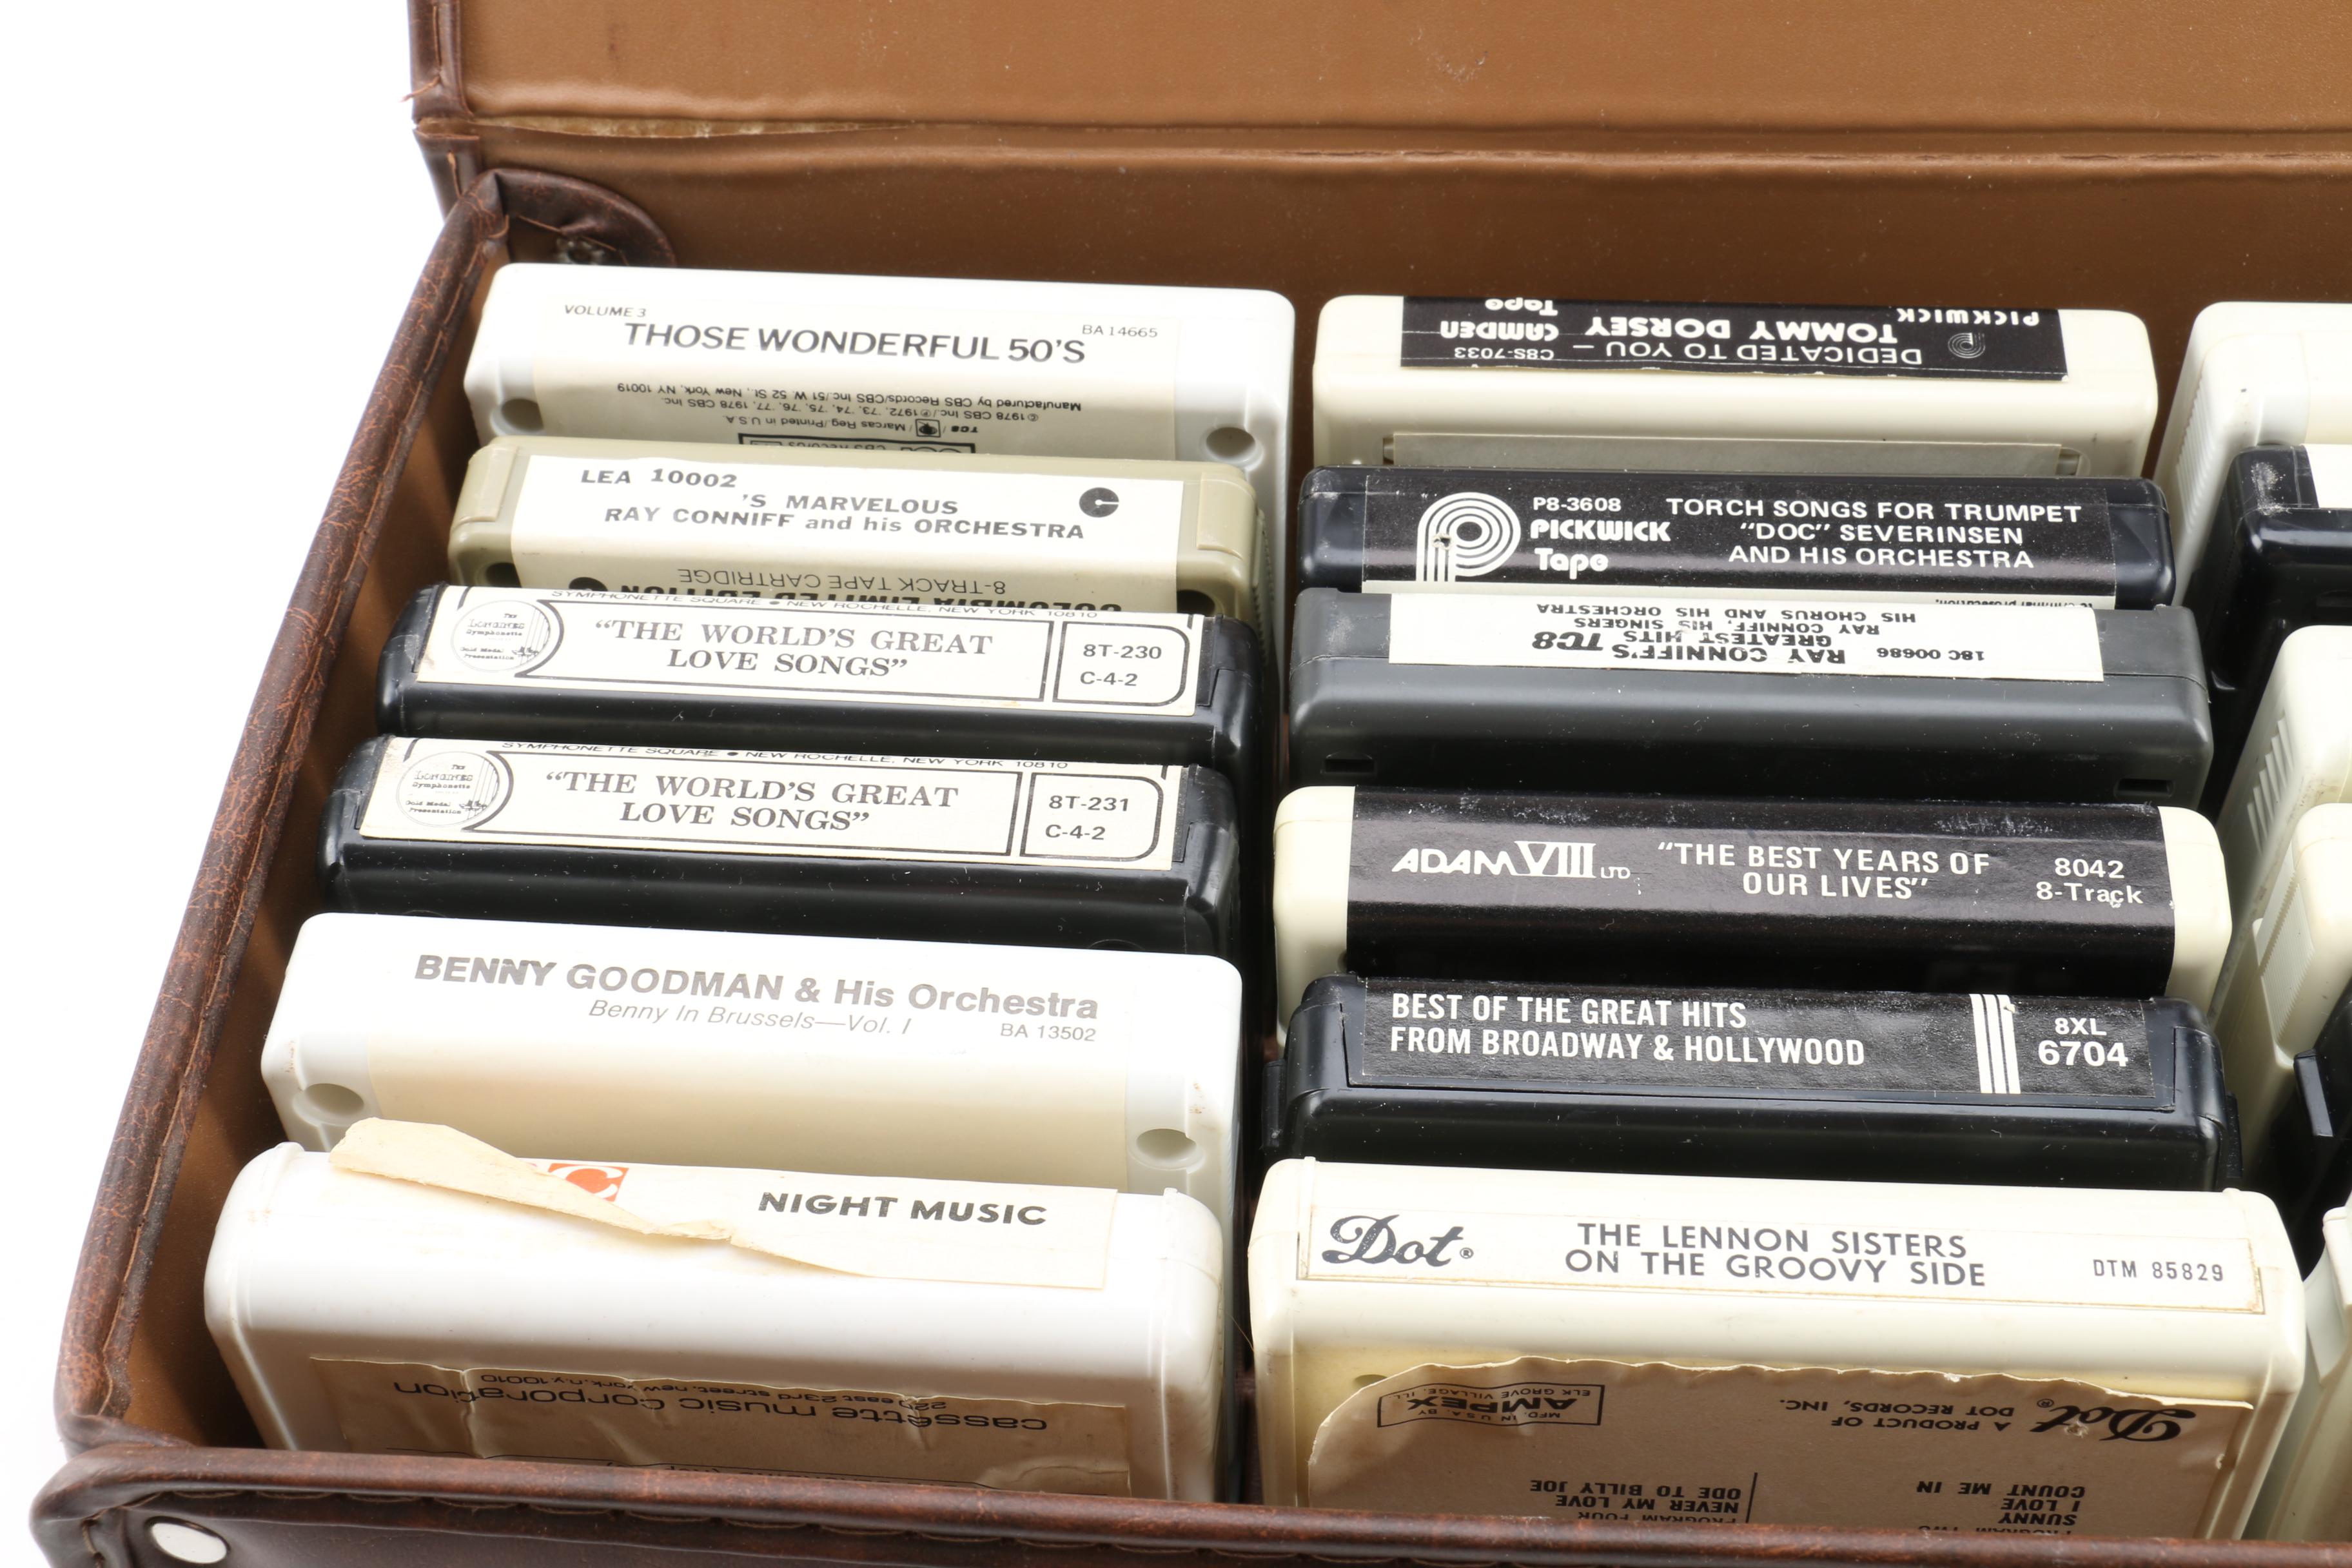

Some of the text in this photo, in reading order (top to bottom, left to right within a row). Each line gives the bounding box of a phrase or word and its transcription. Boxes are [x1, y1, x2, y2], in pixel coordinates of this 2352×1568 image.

[565, 305, 646, 317] VOLUME 3
[1484, 297, 1558, 317] Tape
[1896, 308, 2039, 327] PICKWICK
[1083, 325, 1157, 337] BA 14665
[1585, 317, 1897, 344] TOMMY DORSEY
[625, 323, 1084, 363] THOSE WONDERFUL 50'S
[1454, 346, 1554, 360] C8S-7033
[1606, 342, 1922, 364] DEDICATED TO YOU
[618, 384, 652, 393] 10019
[658, 386, 676, 395] NY
[681, 385, 711, 395] York,
[715, 388, 743, 398] New
[772, 390, 788, 400] 52
[945, 398, 973, 408] CBS
[977, 397, 992, 409] by
[996, 400, 1081, 411] Manufactured
[582, 469, 736, 487] LEA 10002
[787, 496, 957, 514] MARVELOUS
[1533, 497, 1621, 513] P8-3608
[1666, 498, 2081, 522] TORCH SONGS FOR TRUMPET
[605, 507, 1083, 538] RAY CONNIFF and his ORCHESTRA
[1529, 520, 1671, 542] PICKWICK
[1840, 524, 2023, 545] SEVERINSEN
[1534, 548, 1609, 579] Tape
[1728, 545, 2035, 569] AND HIS ORCHESTRA
[678, 569, 1005, 594] 8-TRACK TAPE CARTRIDGE
[1537, 604, 1916, 623] HIS CHORUS AND HIS ORCHESTRA
[1574, 618, 1879, 635] RAY CONNIFF, HIS SINGERS
[871, 631, 992, 654] GREAT
[1533, 631, 1603, 652] TC8
[1623, 631, 1831, 647] GREATEST HITS
[667, 649, 758, 670] LOVE
[1083, 643, 1163, 660] 8T-230
[1612, 645, 1845, 664] RAY CONNIFF'S
[1877, 648, 1984, 661] 18C 00686
[1079, 671, 1138, 688] C-4-2
[832, 783, 958, 807] GREAT
[1048, 795, 1130, 813] 8T-231
[620, 802, 714, 824] LOVE
[1044, 823, 1107, 841] C-4-2
[1749, 846, 1821, 868] BEST
[1834, 848, 1939, 873] YEARS
[1950, 851, 1992, 874] OF
[2054, 858, 2124, 879] 8042
[1743, 872, 1807, 895] OUR
[2036, 881, 2144, 906] 8-Track
[415, 955, 1097, 1019] BENNY GOODMAN & His Orchestra
[589, 1000, 669, 1023] Benny
[676, 1005, 698, 1021] In
[1391, 993, 1747, 1029] BEST OF THE GREAT HITS
[1001, 1023, 1095, 1041] BA 13502
[2054, 1017, 2107, 1037] 8XL
[1391, 1026, 1864, 1065] FROM BROADWAY & HOLLYWOOD
[2037, 1042, 2129, 1068] 6704
[759, 1192, 1046, 1225] NIGHT MUSIC
[1578, 1223, 1966, 1258] THE LENNON SISTERS
[1565, 1250, 1984, 1286] ON THE GROOVY SIDE
[2093, 1259, 2223, 1281] DTM 85829
[391, 1382, 1048, 1429] cassette music corporation
[1407, 1396, 1576, 1413] AMPEX
[1780, 1400, 2014, 1416] DOT RECORDS, INC.
[1831, 1416, 2011, 1431] A PRODUCT OF
[1531, 1480, 1741, 1500] ODE TO BILLY JOE
[1917, 1481, 2085, 1498] COUNT ME IN
[1556, 1495, 1739, 1513] NEVER MY LOVE
[2001, 1495, 2080, 1512] I LOVE
[1998, 1513, 2077, 1527] SUNNY
